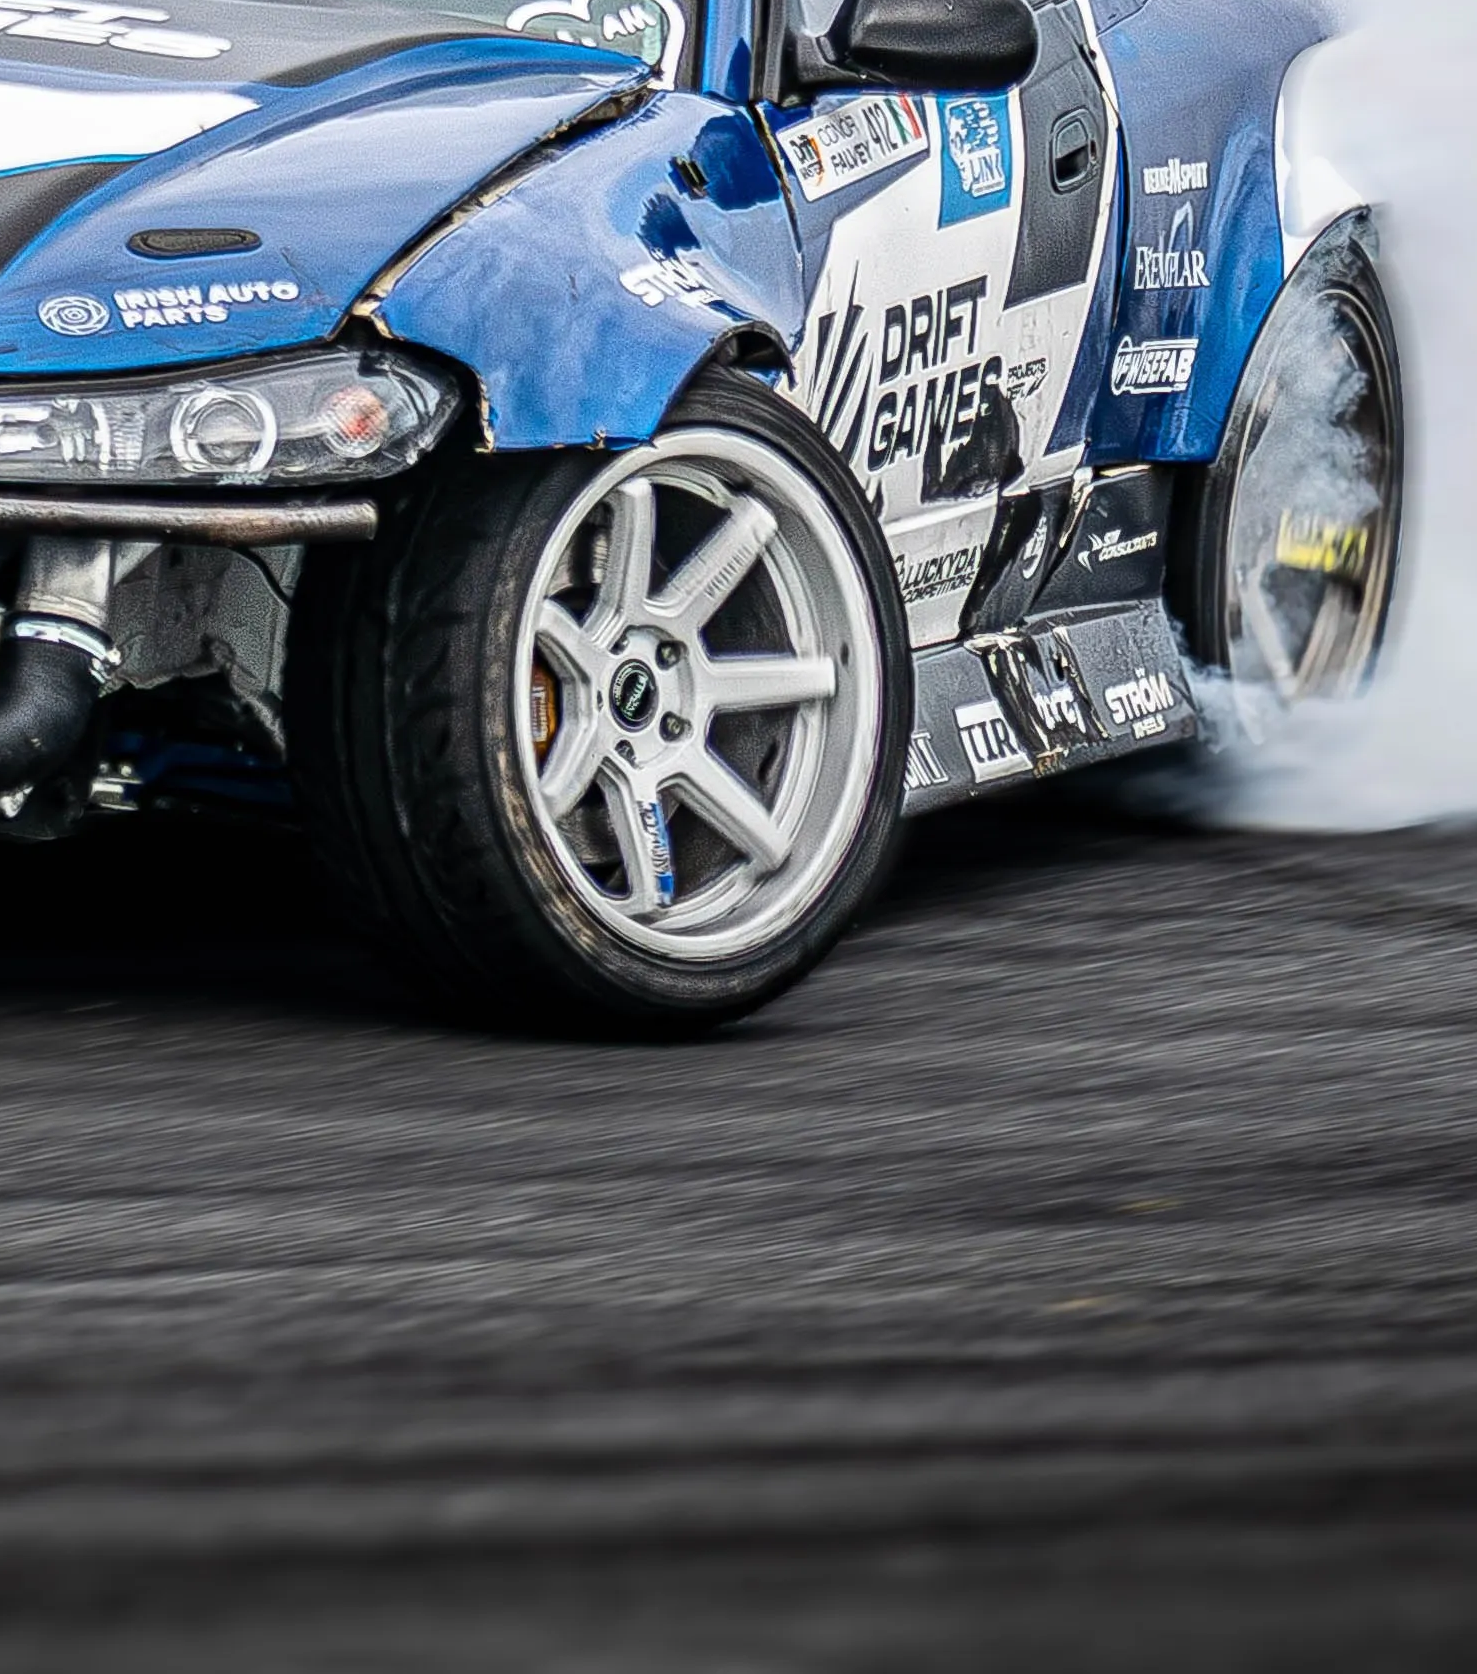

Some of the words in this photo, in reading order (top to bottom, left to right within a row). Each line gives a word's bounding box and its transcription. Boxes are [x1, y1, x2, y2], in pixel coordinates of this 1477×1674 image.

[861, 102, 898, 157] 412
[113, 285, 203, 311] IRISH
[208, 280, 300, 305] AUTO
[119, 305, 229, 329] PARTS
[878, 274, 989, 386] DRIFT
[867, 355, 1004, 472] GAMES
[904, 544, 985, 589] LUCKYDAY
[1104, 667, 1175, 724] STRÖM
